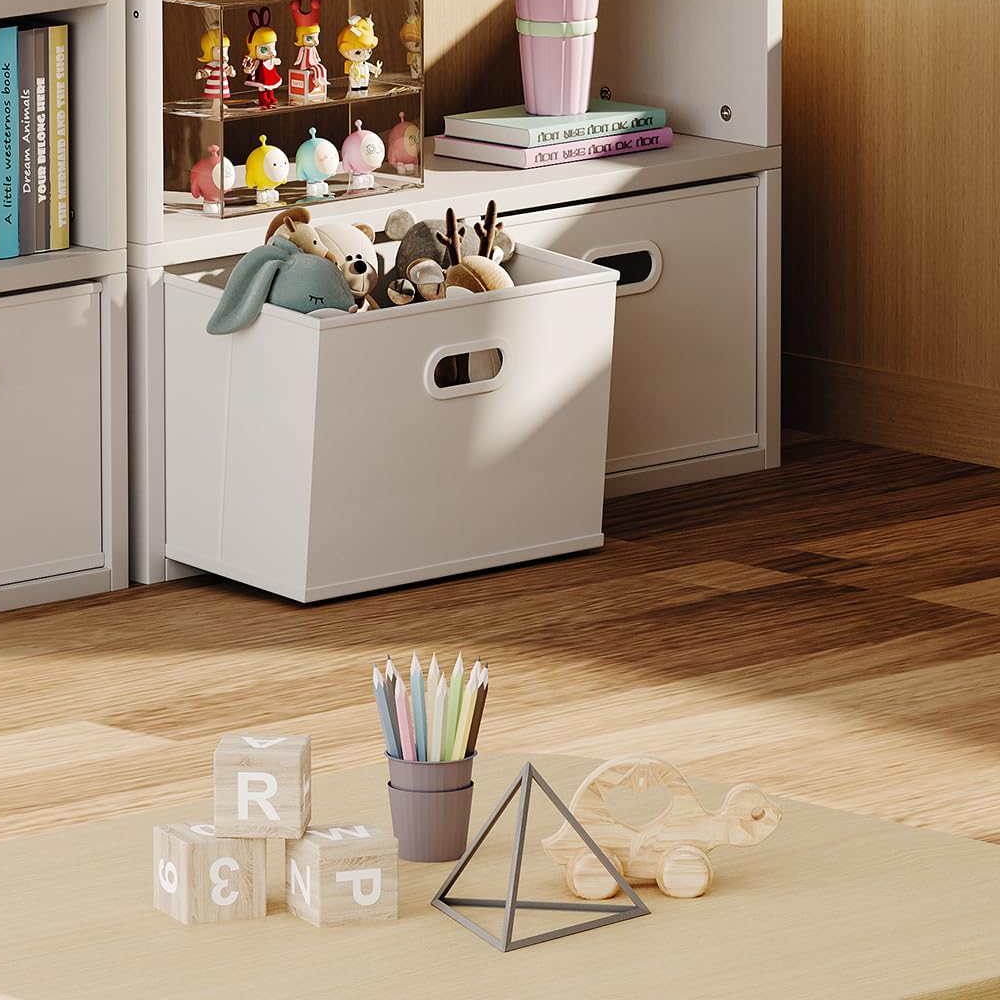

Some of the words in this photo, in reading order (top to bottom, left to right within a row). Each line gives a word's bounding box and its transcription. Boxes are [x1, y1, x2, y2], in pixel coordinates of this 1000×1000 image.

[2, 62, 11, 95] book
[36, 77, 46, 112] HERE
[3, 100, 12, 170] westernos
[20, 89, 31, 144] Animals
[37, 114, 46, 163] BELONG
[22, 148, 32, 193] Dream
[37, 166, 47, 203] YOUR
[3, 175, 12, 208] little
[4, 214, 12, 224] A
[237, 772, 280, 821] R
[336, 868, 382, 906] P
